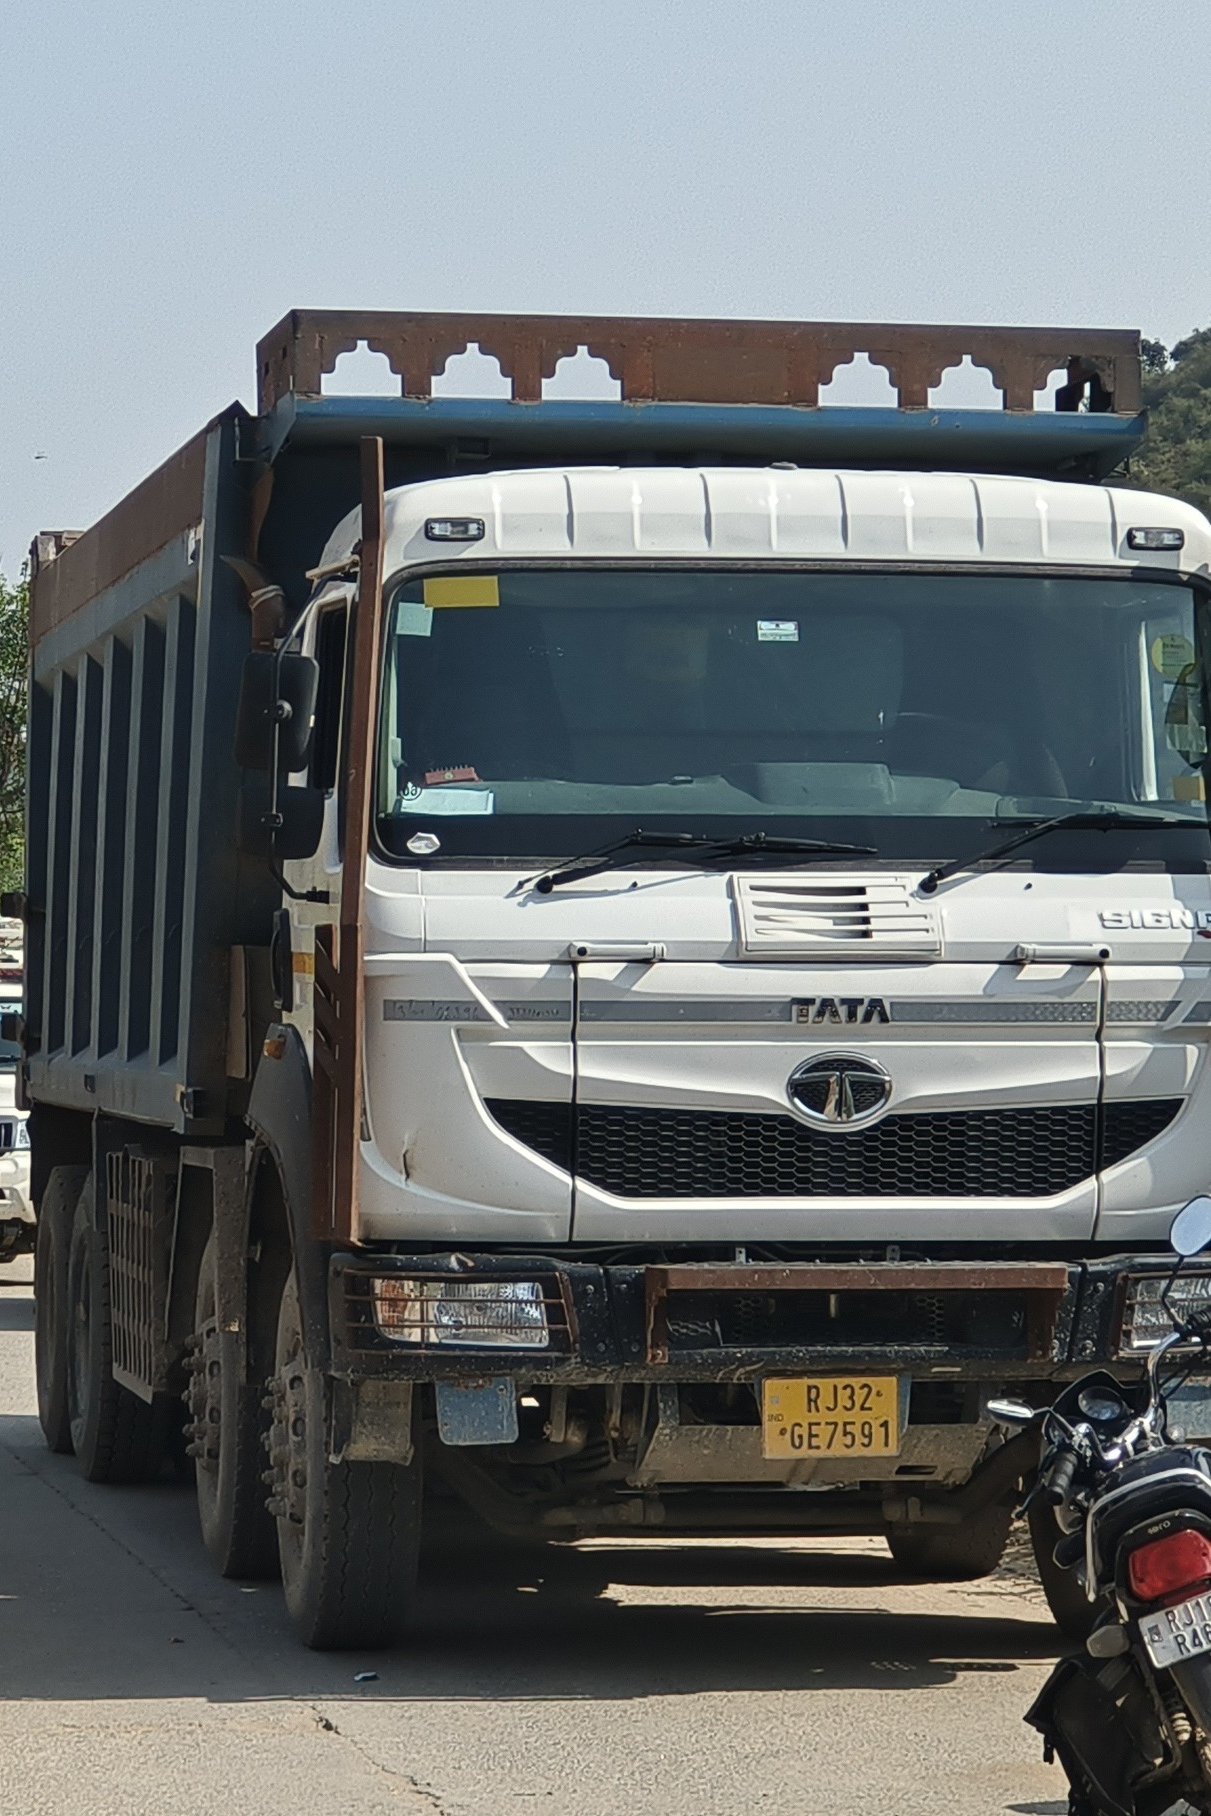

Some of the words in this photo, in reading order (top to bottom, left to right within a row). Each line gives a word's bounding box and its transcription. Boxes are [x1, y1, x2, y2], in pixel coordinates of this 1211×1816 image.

[790, 997, 890, 1024] TATA
[806, 1383, 873, 1413] RJ32
[767, 1413, 784, 1423] IND
[790, 1419, 890, 1450] GE7591
